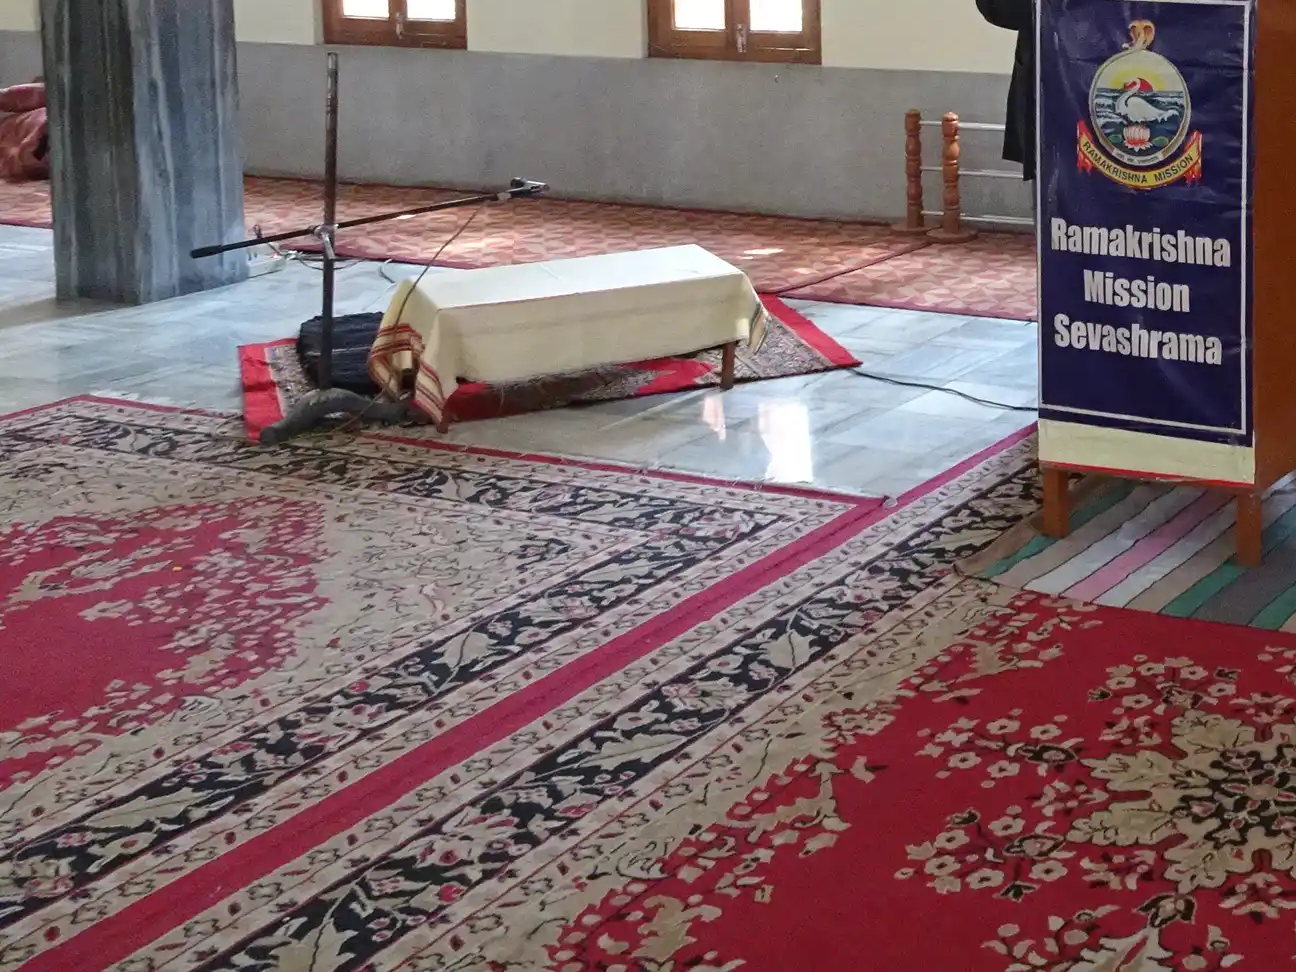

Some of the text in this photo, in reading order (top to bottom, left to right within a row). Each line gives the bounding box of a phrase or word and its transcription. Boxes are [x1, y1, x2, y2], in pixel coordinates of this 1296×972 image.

[1082, 139, 1194, 184] RAMAKRISHNA MISSION
[1051, 217, 1231, 267] Ramakrishna
[1083, 268, 1190, 313] Mission
[1054, 313, 1222, 366] Sevashrama
